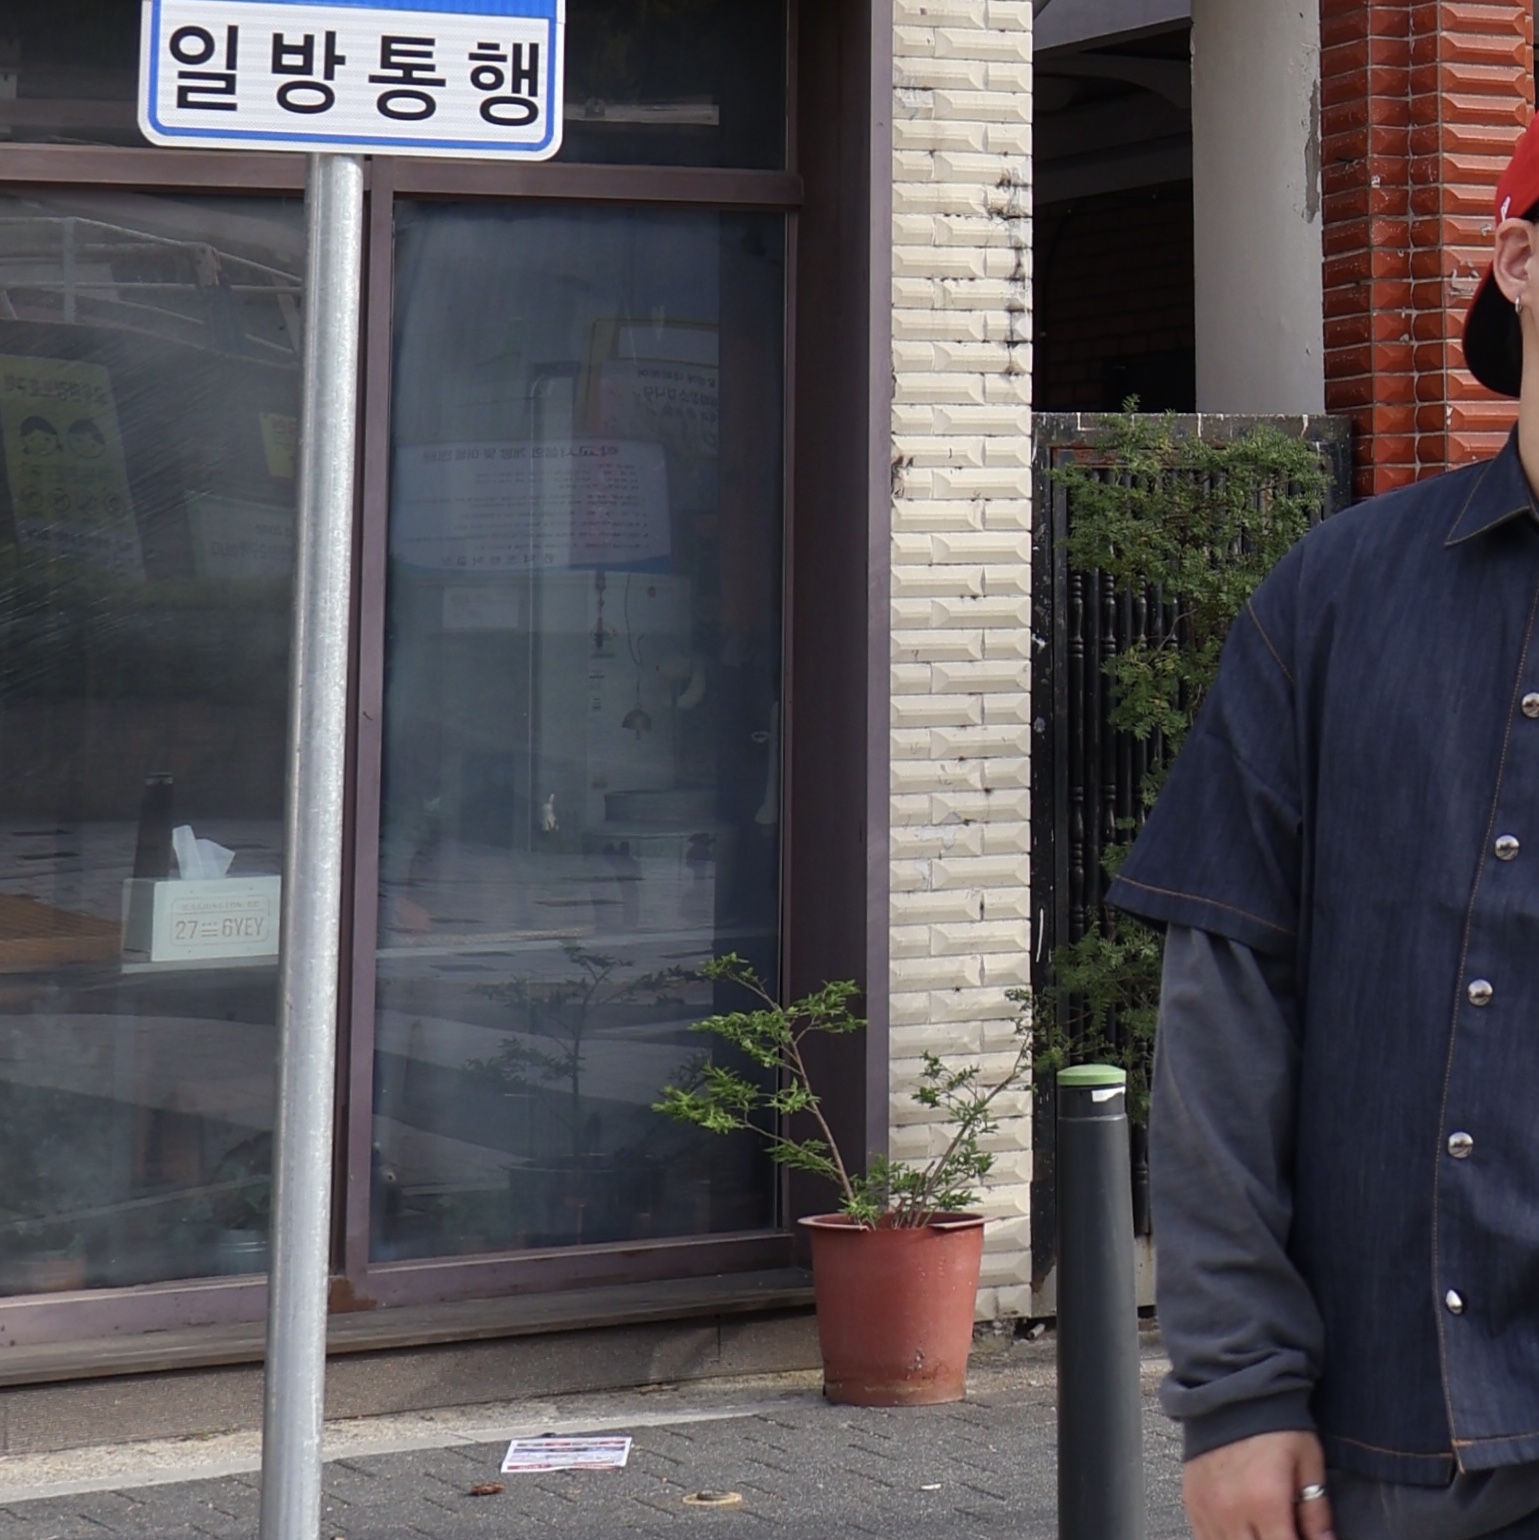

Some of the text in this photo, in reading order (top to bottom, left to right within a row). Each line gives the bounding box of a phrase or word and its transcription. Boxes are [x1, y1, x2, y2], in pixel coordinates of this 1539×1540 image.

[168, 24, 541, 127] 일방통행
[175, 916, 265, 941] 27 6YEY
